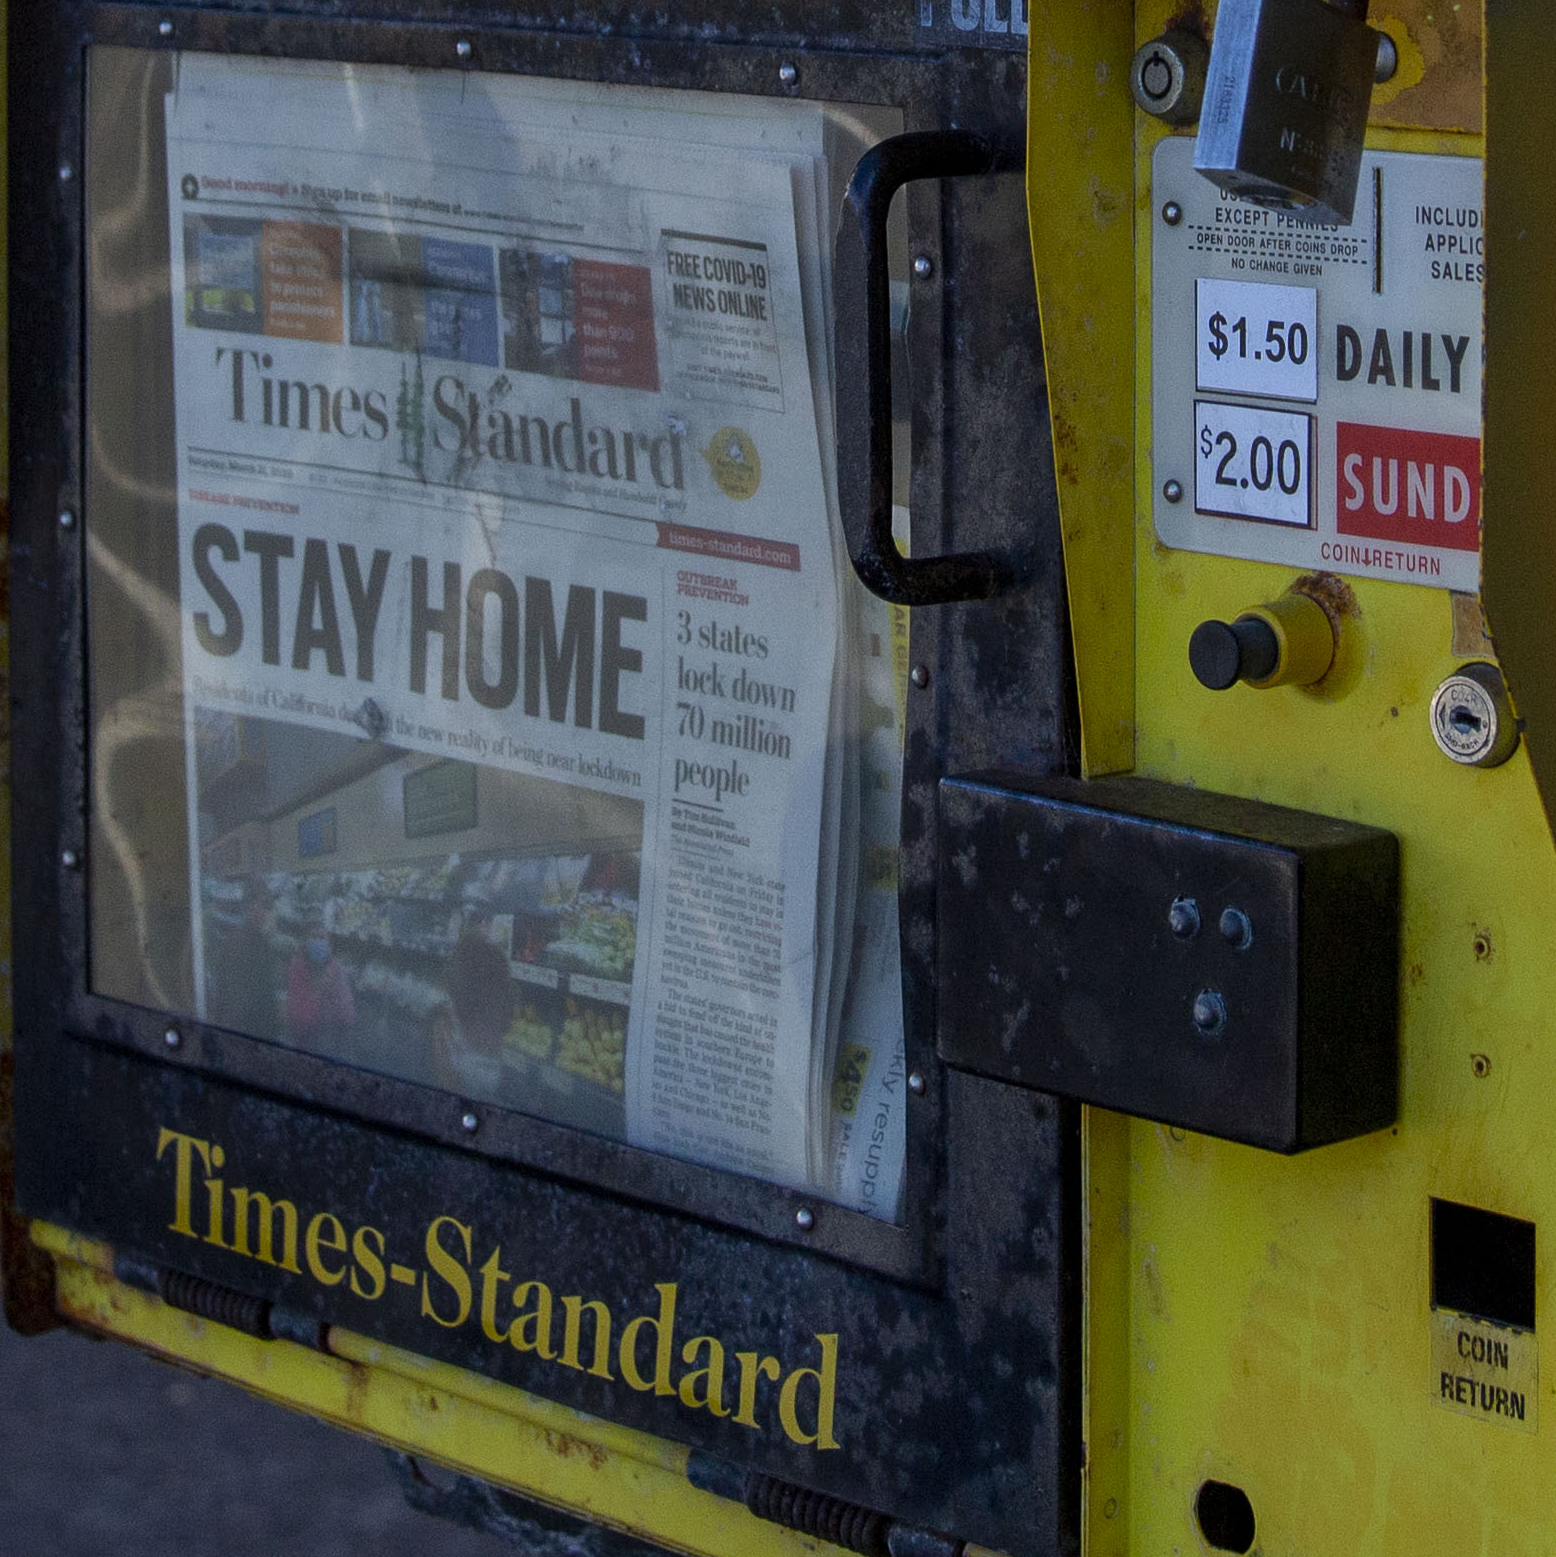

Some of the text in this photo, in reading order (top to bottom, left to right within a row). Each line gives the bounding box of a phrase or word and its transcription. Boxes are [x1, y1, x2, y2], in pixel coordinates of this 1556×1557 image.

[1215, 207, 1269, 227] EXCEPT
[666, 249, 767, 290] FREE COVID-19
[1196, 232, 1359, 257] OPEN DOOR AFTER COINS DROP
[1231, 257, 1323, 277] NO CHANGE GIVEN
[672, 282, 768, 322] NEWS ONLINE
[1208, 310, 1308, 365] $1.50
[1336, 324, 1471, 394] DAILY
[216, 346, 685, 491] Times Standard
[1200, 424, 1301, 495] $2.00
[1343, 453, 1481, 526] SUND
[668, 530, 792, 566] times-standard.com
[1320, 541, 1441, 576] COIN RETURN
[675, 569, 738, 592] OUTBREAK
[675, 583, 750, 607] PREVENTION
[192, 522, 649, 741] STAY HOME
[676, 609, 770, 661] 3 states
[676, 655, 797, 714] lock down
[396, 714, 414, 737] the
[417, 723, 443, 743] new
[447, 727, 489, 758] reality
[491, 736, 508, 757] of
[508, 738, 545, 768] being
[546, 750, 575, 773] near
[577, 753, 642, 788] lockdown
[676, 701, 793, 761] 70 million
[673, 757, 751, 803] people
[156, 1125, 842, 1451] Times-Standard
[1456, 1330, 1509, 1369] COIN
[1440, 1371, 1526, 1421] RETURN
